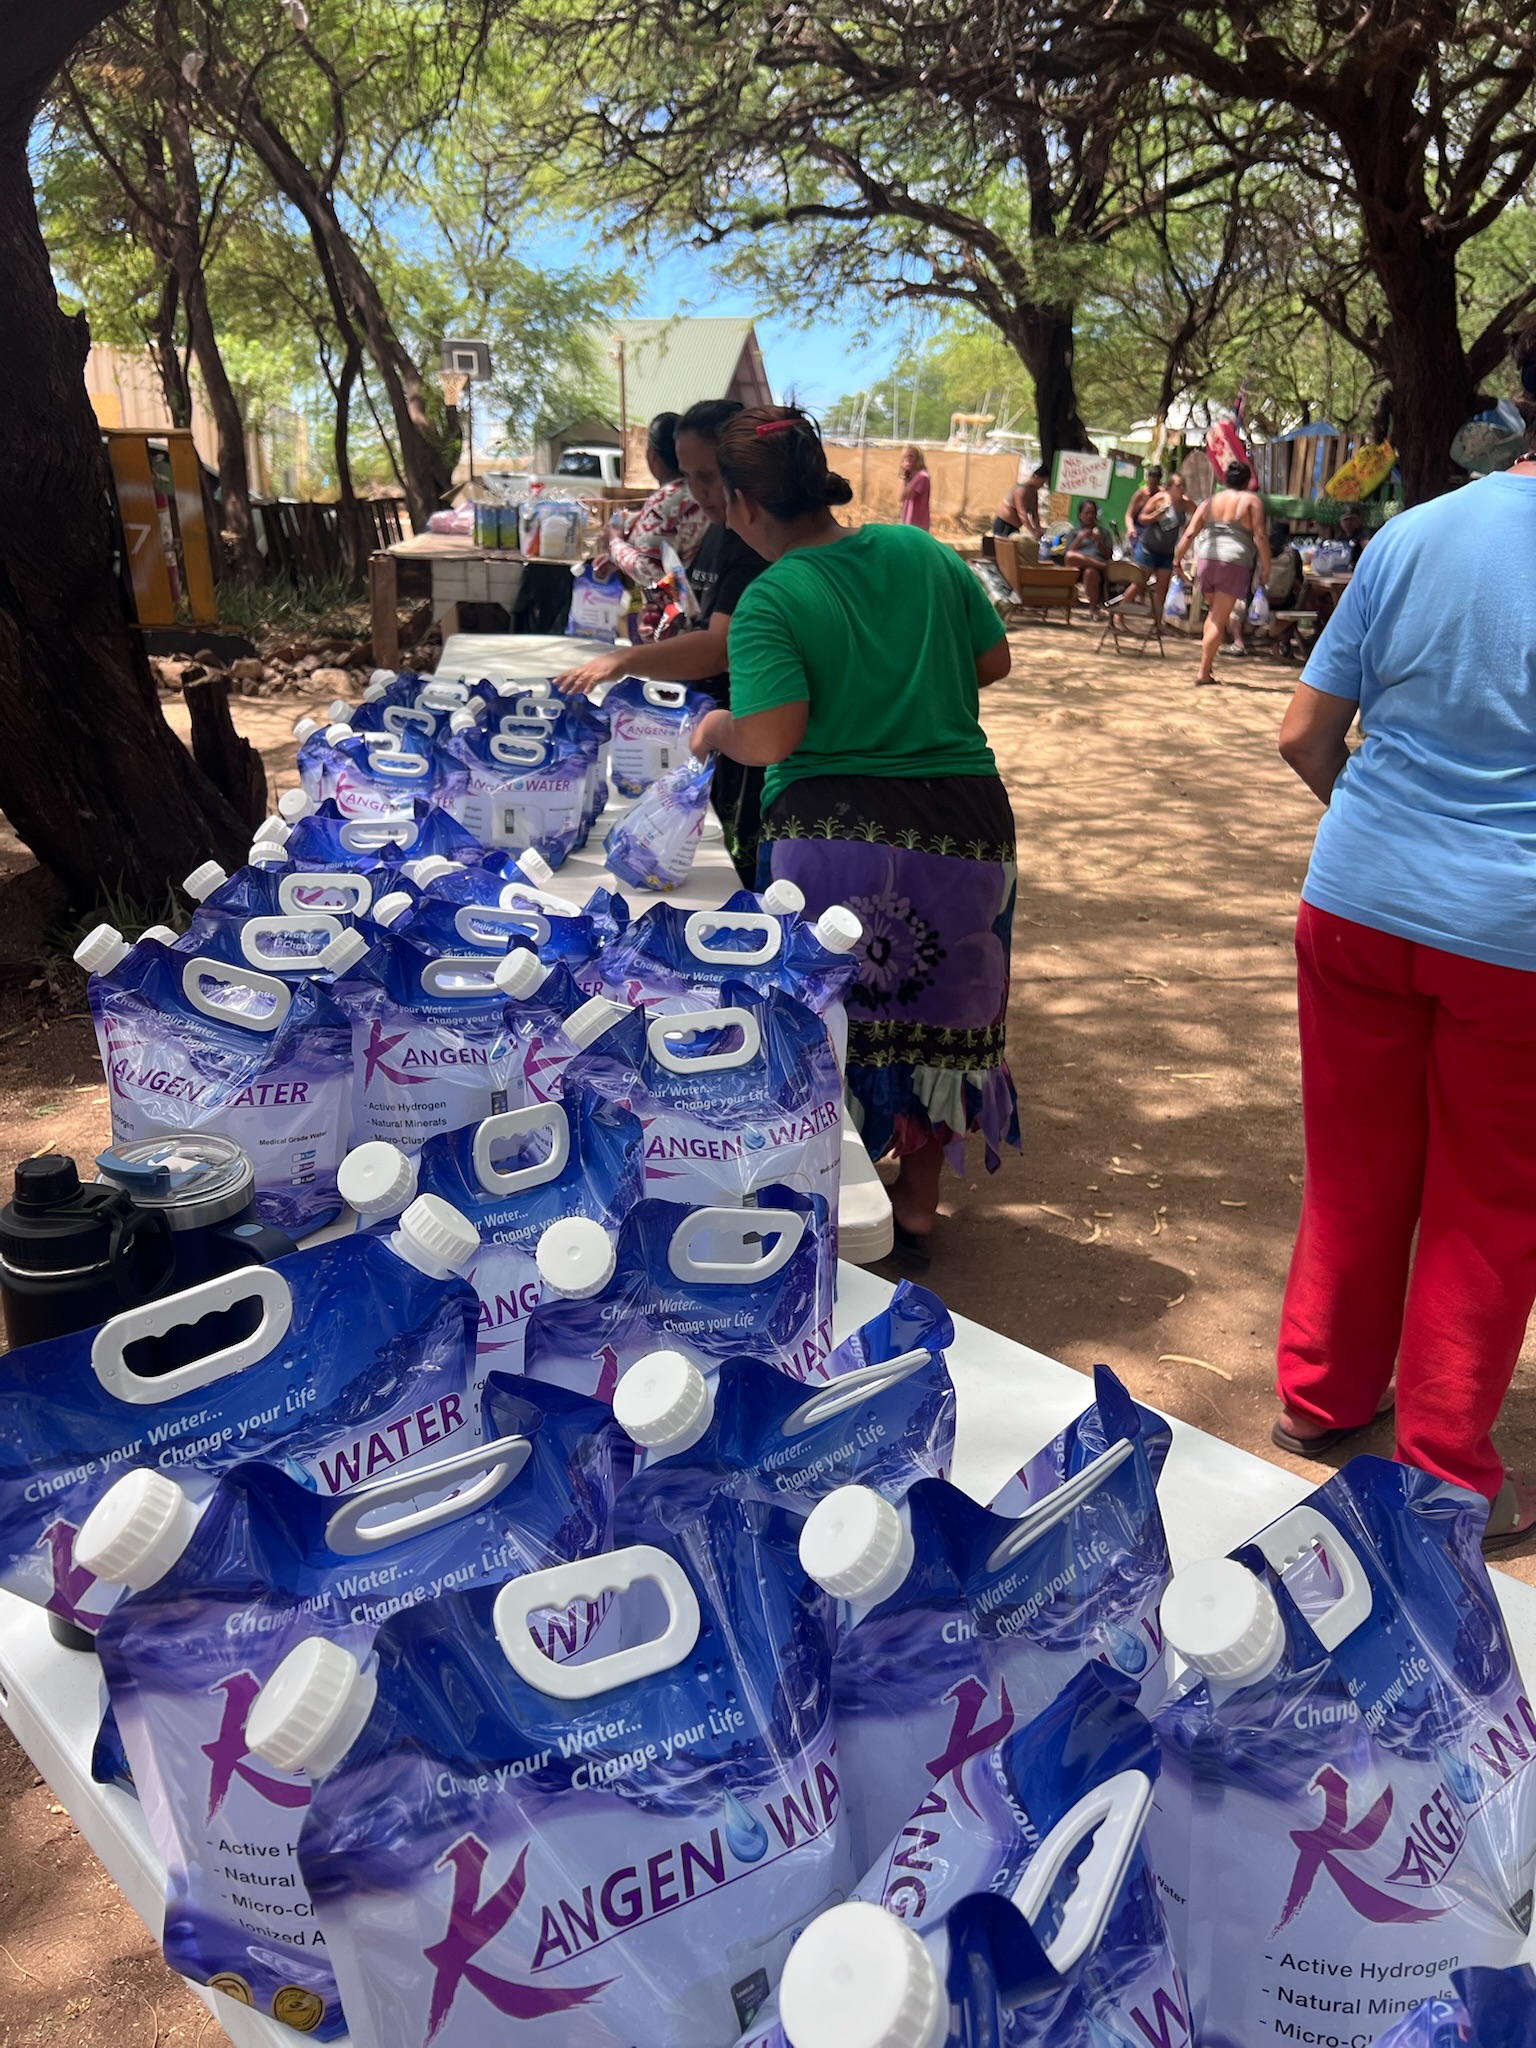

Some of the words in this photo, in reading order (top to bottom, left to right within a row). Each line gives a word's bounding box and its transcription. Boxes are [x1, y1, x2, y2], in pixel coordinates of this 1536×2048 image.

[123, 522, 151, 555] 7
[526, 780, 570, 791] WATER
[632, 958, 671, 978] Change
[113, 993, 157, 1018] Change
[158, 1009, 183, 1027] your
[426, 1016, 464, 1027] Change
[466, 1015, 489, 1027] your
[363, 1017, 489, 1096] KANGEN
[369, 1102, 395, 1111] Active
[398, 1101, 447, 1112] Hydrogen
[673, 1097, 719, 1112] Change
[719, 1093, 746, 1111] your
[748, 1089, 770, 1103] Life
[371, 1118, 403, 1128] Natural
[404, 1117, 447, 1128] Minerals
[645, 1134, 742, 1161] ANGEN
[768, 1100, 839, 1147] WATER
[484, 1209, 529, 1229] Water...
[492, 1222, 538, 1246] Change
[659, 1298, 702, 1316] Water...
[663, 1318, 705, 1335] Change
[707, 1317, 732, 1335] your
[734, 1312, 755, 1328] Life
[157, 1425, 233, 1469] Change
[236, 1403, 281, 1440] your
[284, 1385, 317, 1414] Life
[23, 1463, 97, 1504] Change
[99, 1437, 143, 1473] your
[147, 1407, 224, 1448] Water...
[318, 1391, 465, 1495] WATER
[763, 1443, 812, 1474] Water...
[775, 1461, 825, 1494] Change
[825, 1442, 856, 1473] your
[855, 1422, 887, 1448] Life
[336, 1562, 415, 1601] Water...
[350, 1584, 427, 1628] Change
[428, 1561, 477, 1600] your
[481, 1542, 520, 1574] Life
[976, 1572, 1031, 1616] Water...
[995, 1592, 1045, 1640] Change
[1045, 1564, 1078, 1606] your
[1076, 1538, 1111, 1572] Life
[1383, 1677, 1404, 1715] your
[1402, 1654, 1432, 1689] Life
[1293, 1699, 1358, 1731] Chang
[494, 1747, 552, 1794] your
[556, 1717, 643, 1760] Water...
[570, 1742, 658, 1792] Change
[659, 1722, 706, 1762] your
[708, 1707, 746, 1736] Life
[218, 1838, 281, 1858] Active
[224, 1866, 296, 1888] Natural
[231, 1892, 315, 1918] Micro-Cl
[238, 1918, 305, 1946] Ionized
[423, 1832, 726, 2048] KANGEN
[1279, 1952, 1353, 1979] Active
[1360, 1955, 1460, 1983] Hydrogen
[1276, 1986, 1361, 2015] Natural
